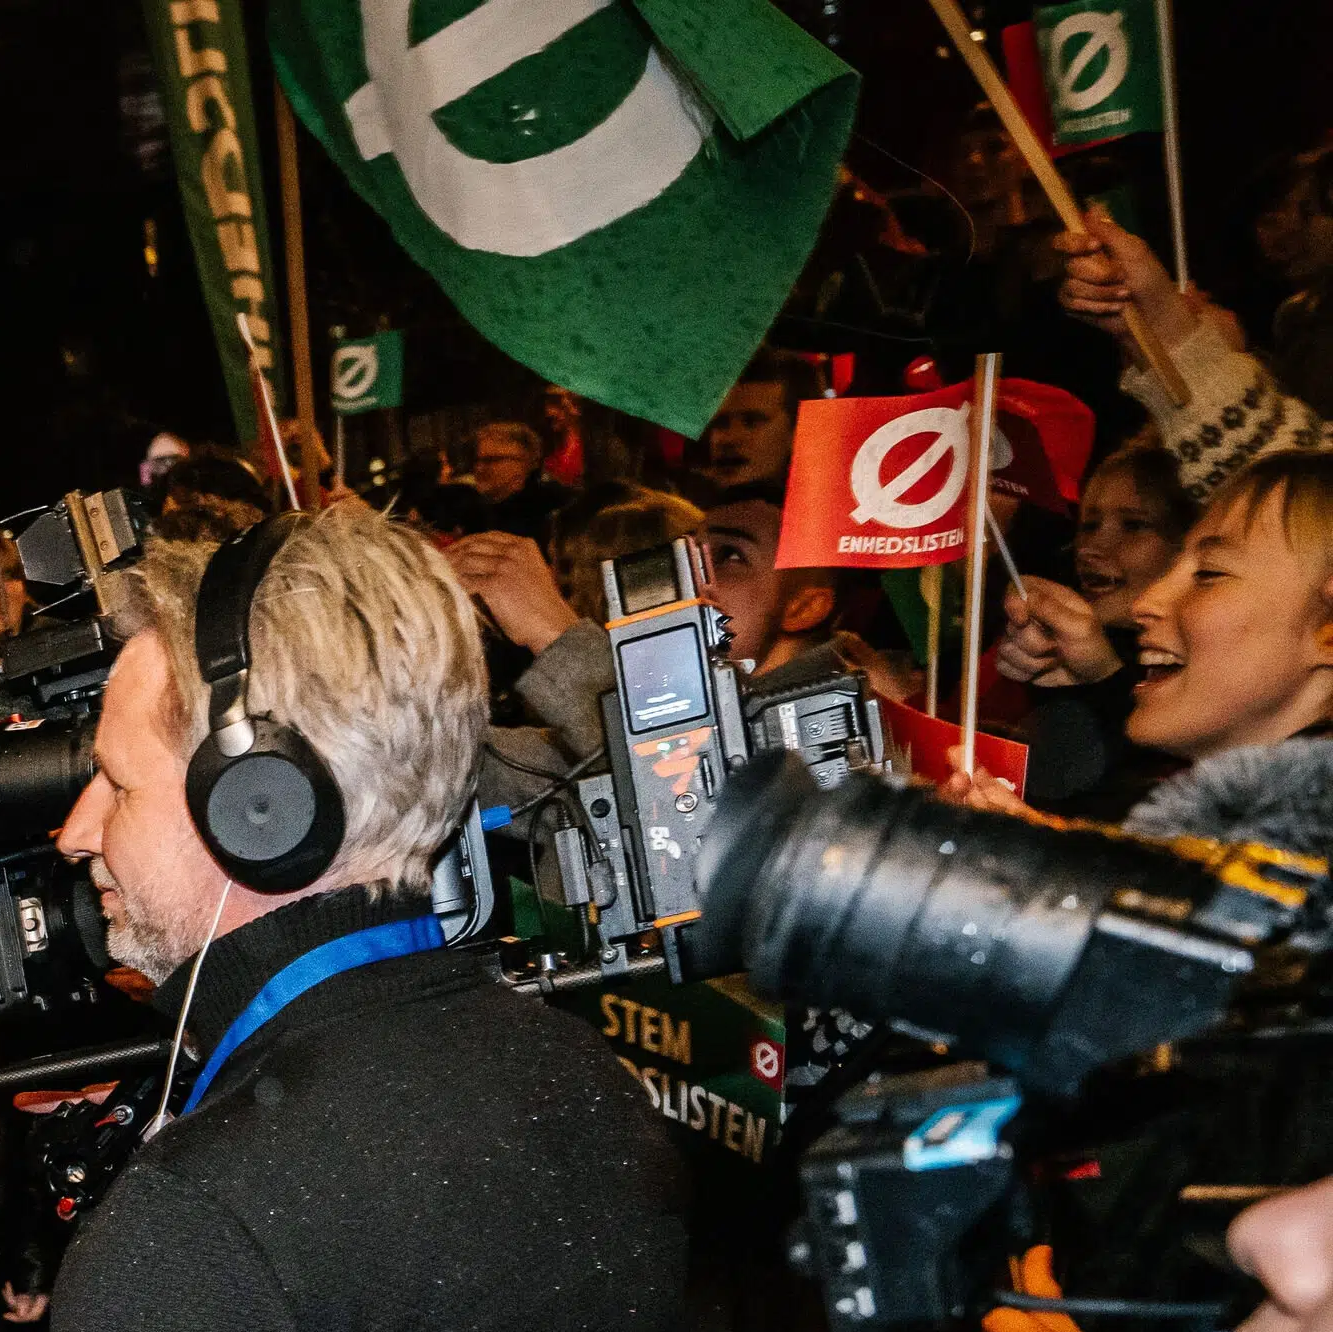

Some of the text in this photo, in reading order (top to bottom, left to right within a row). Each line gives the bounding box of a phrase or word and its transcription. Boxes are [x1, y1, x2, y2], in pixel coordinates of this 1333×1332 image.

[837, 528, 966, 554] ENHEDSLISTEN
[600, 993, 692, 1065] STEM
[620, 1056, 767, 1164] SLISTEN
